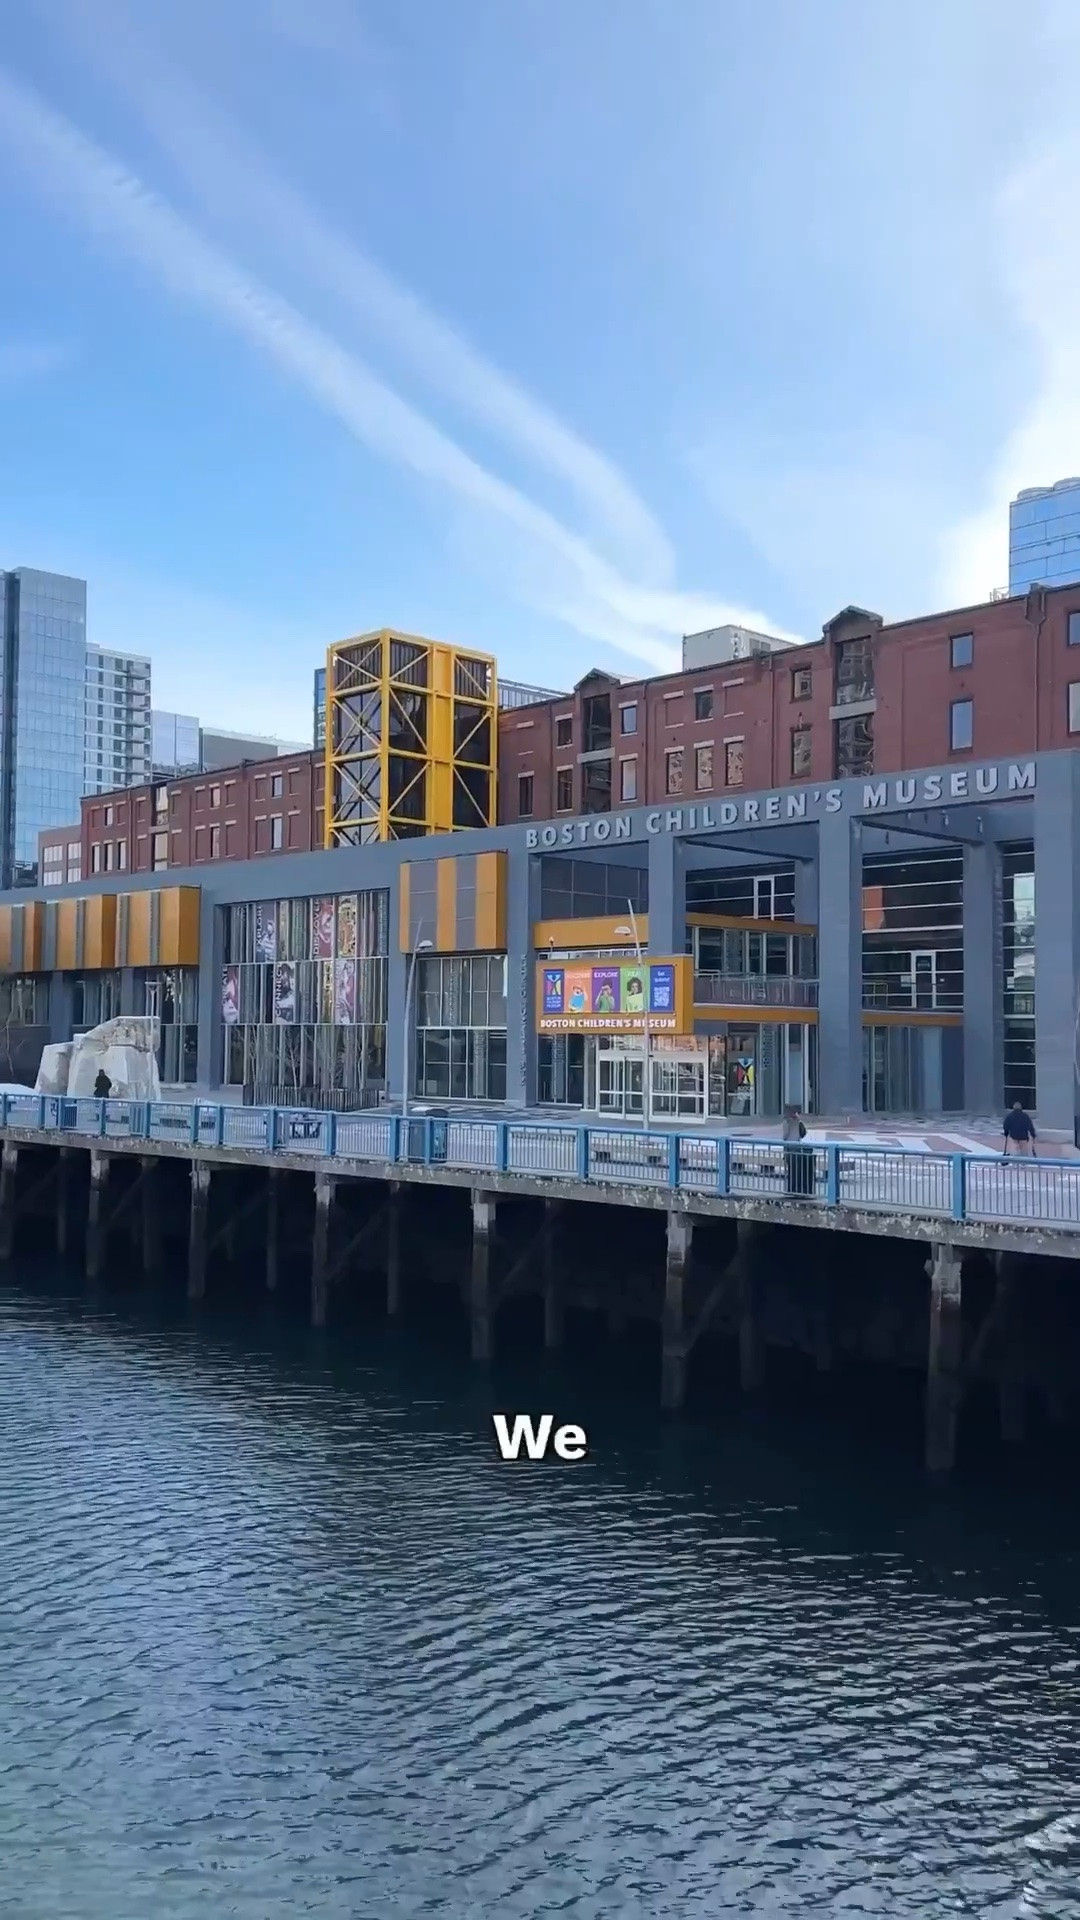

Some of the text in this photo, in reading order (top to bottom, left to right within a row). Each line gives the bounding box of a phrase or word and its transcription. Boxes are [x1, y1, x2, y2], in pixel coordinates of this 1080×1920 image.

[525, 761, 1038, 849] BOSTON CHILDREN'S MUSEUM
[540, 1019, 575, 1028] BOSTON
[578, 1018, 631, 1028] CHILDREN'S
